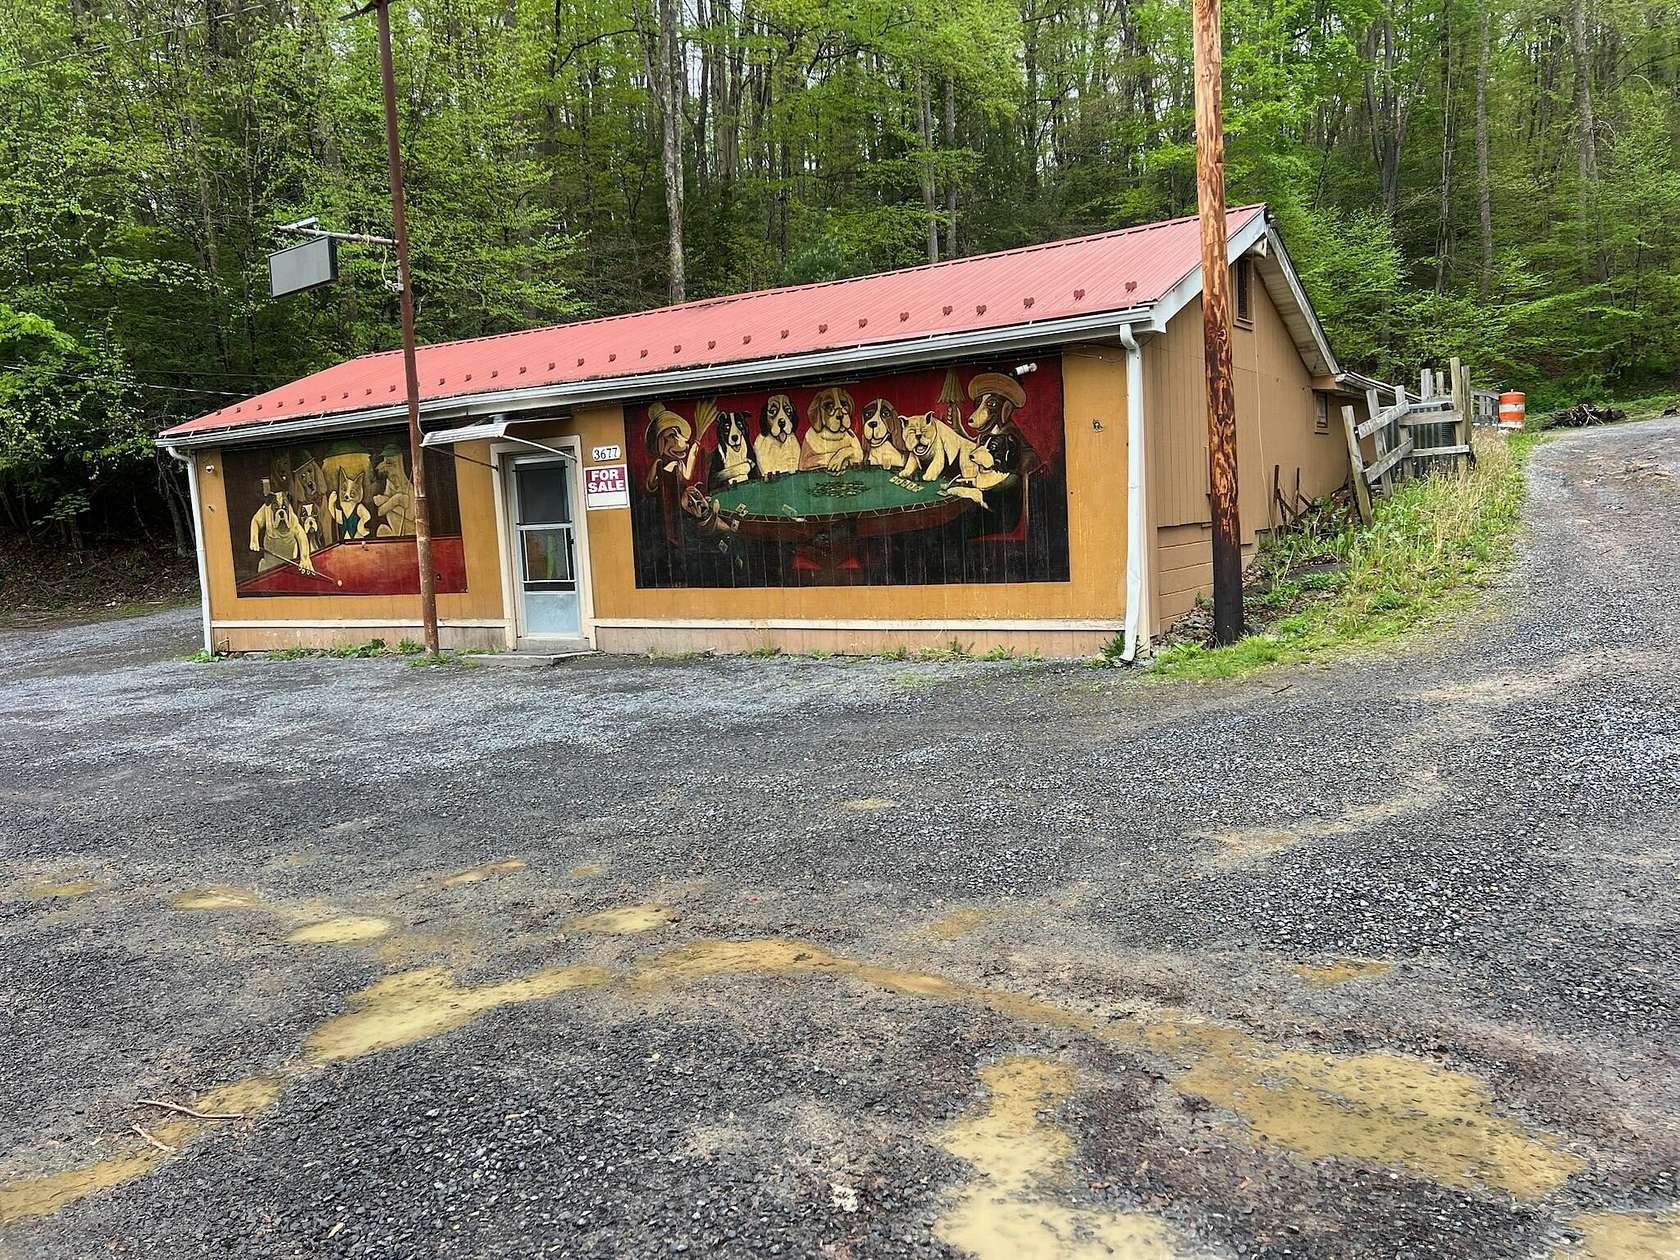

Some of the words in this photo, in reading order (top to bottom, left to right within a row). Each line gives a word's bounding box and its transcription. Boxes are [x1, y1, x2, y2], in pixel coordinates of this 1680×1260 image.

[594, 447, 618, 460] 3677
[591, 469, 619, 481] FOR
[588, 480, 625, 493] SALE
